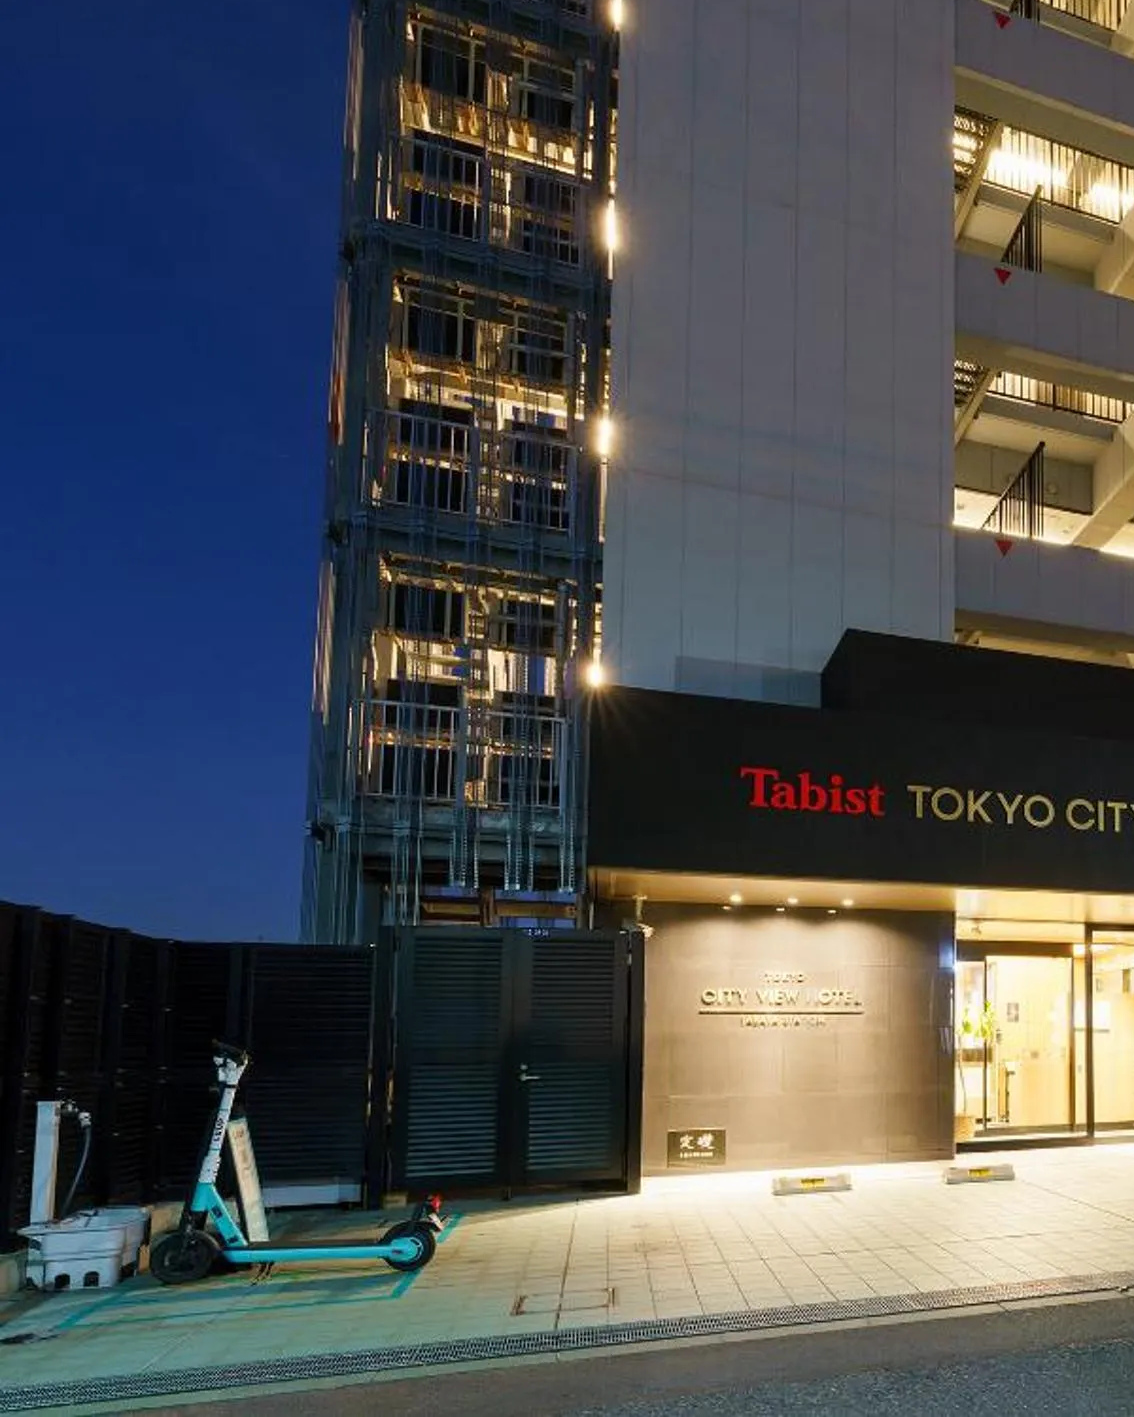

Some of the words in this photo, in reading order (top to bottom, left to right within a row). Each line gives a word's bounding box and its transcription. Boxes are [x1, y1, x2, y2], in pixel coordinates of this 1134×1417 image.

[740, 767, 885, 816] Tabist
[907, 785, 1055, 828] TOKYO
[755, 988, 800, 1006] VIEW
